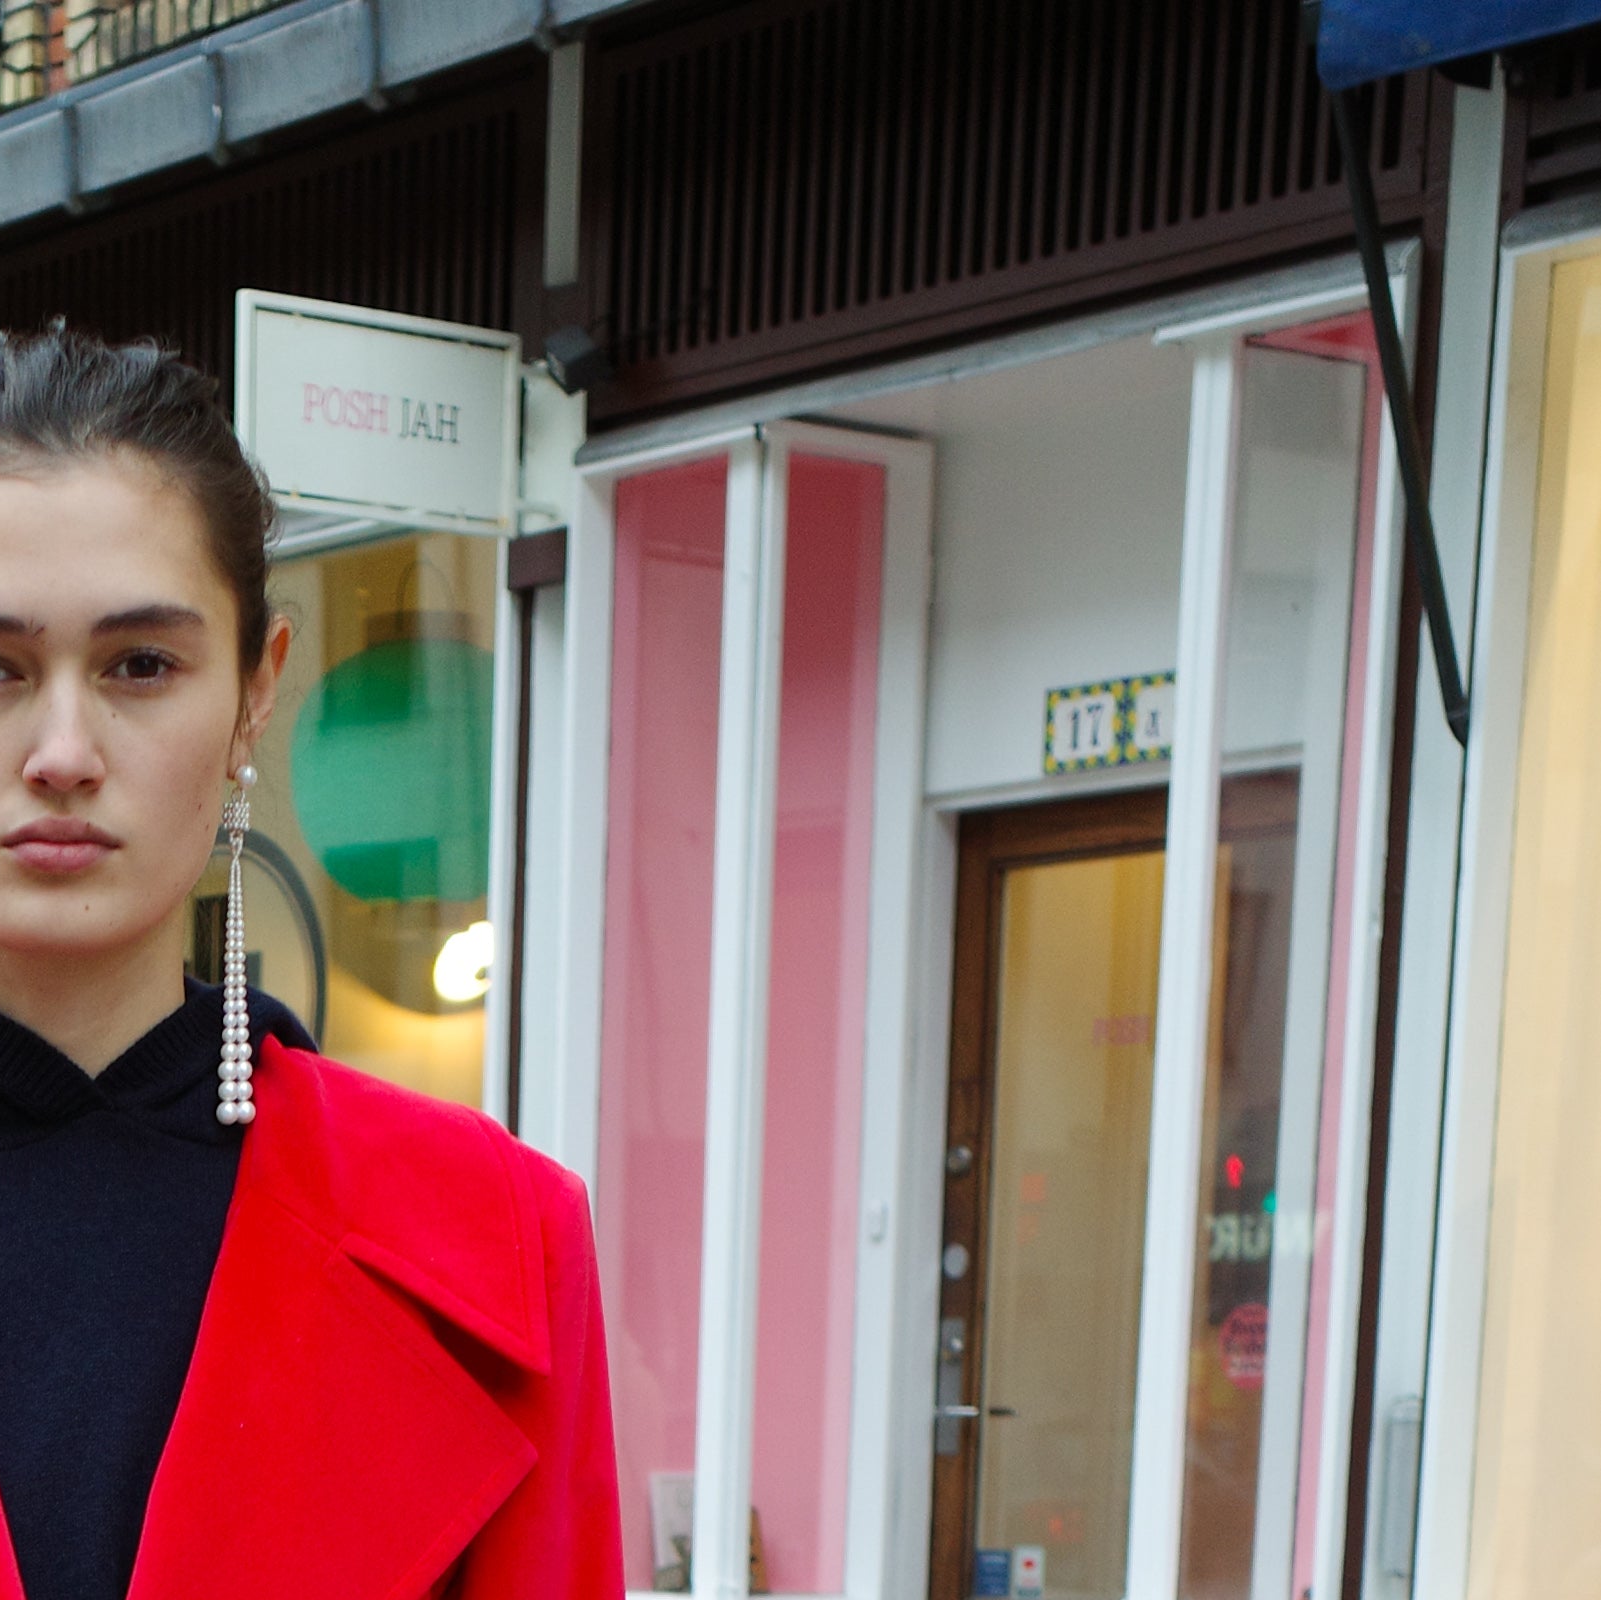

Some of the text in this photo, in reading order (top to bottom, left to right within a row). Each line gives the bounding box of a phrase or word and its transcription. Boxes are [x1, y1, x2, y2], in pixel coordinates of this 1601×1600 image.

[302, 382, 461, 444] POSH JAH
[1068, 702, 1105, 751] 17
